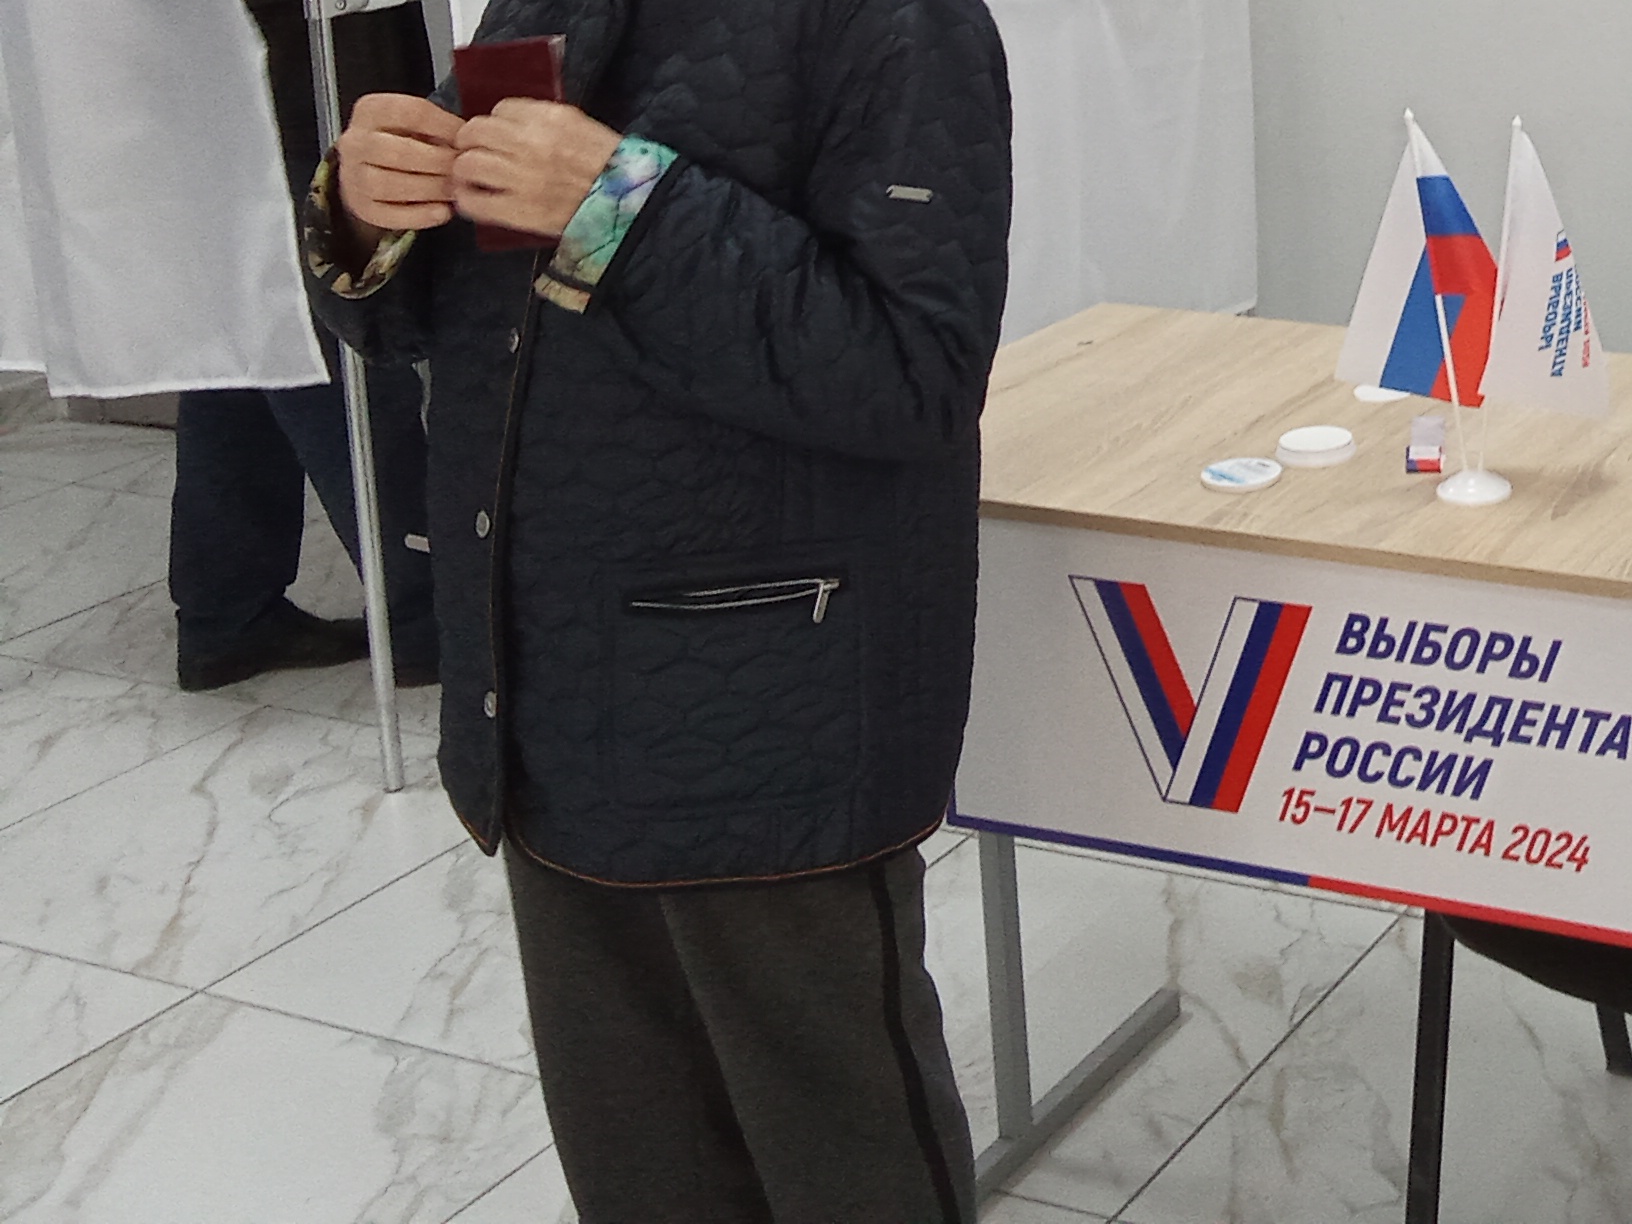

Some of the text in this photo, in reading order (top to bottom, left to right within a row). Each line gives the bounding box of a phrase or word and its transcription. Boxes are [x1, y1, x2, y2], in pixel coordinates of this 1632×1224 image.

[1335, 612, 1563, 683] ВЫБОРЫ
[1292, 730, 1495, 801] РОССИИ
[1375, 802, 1495, 857] МАРТА
[1501, 824, 1591, 873] 2024
